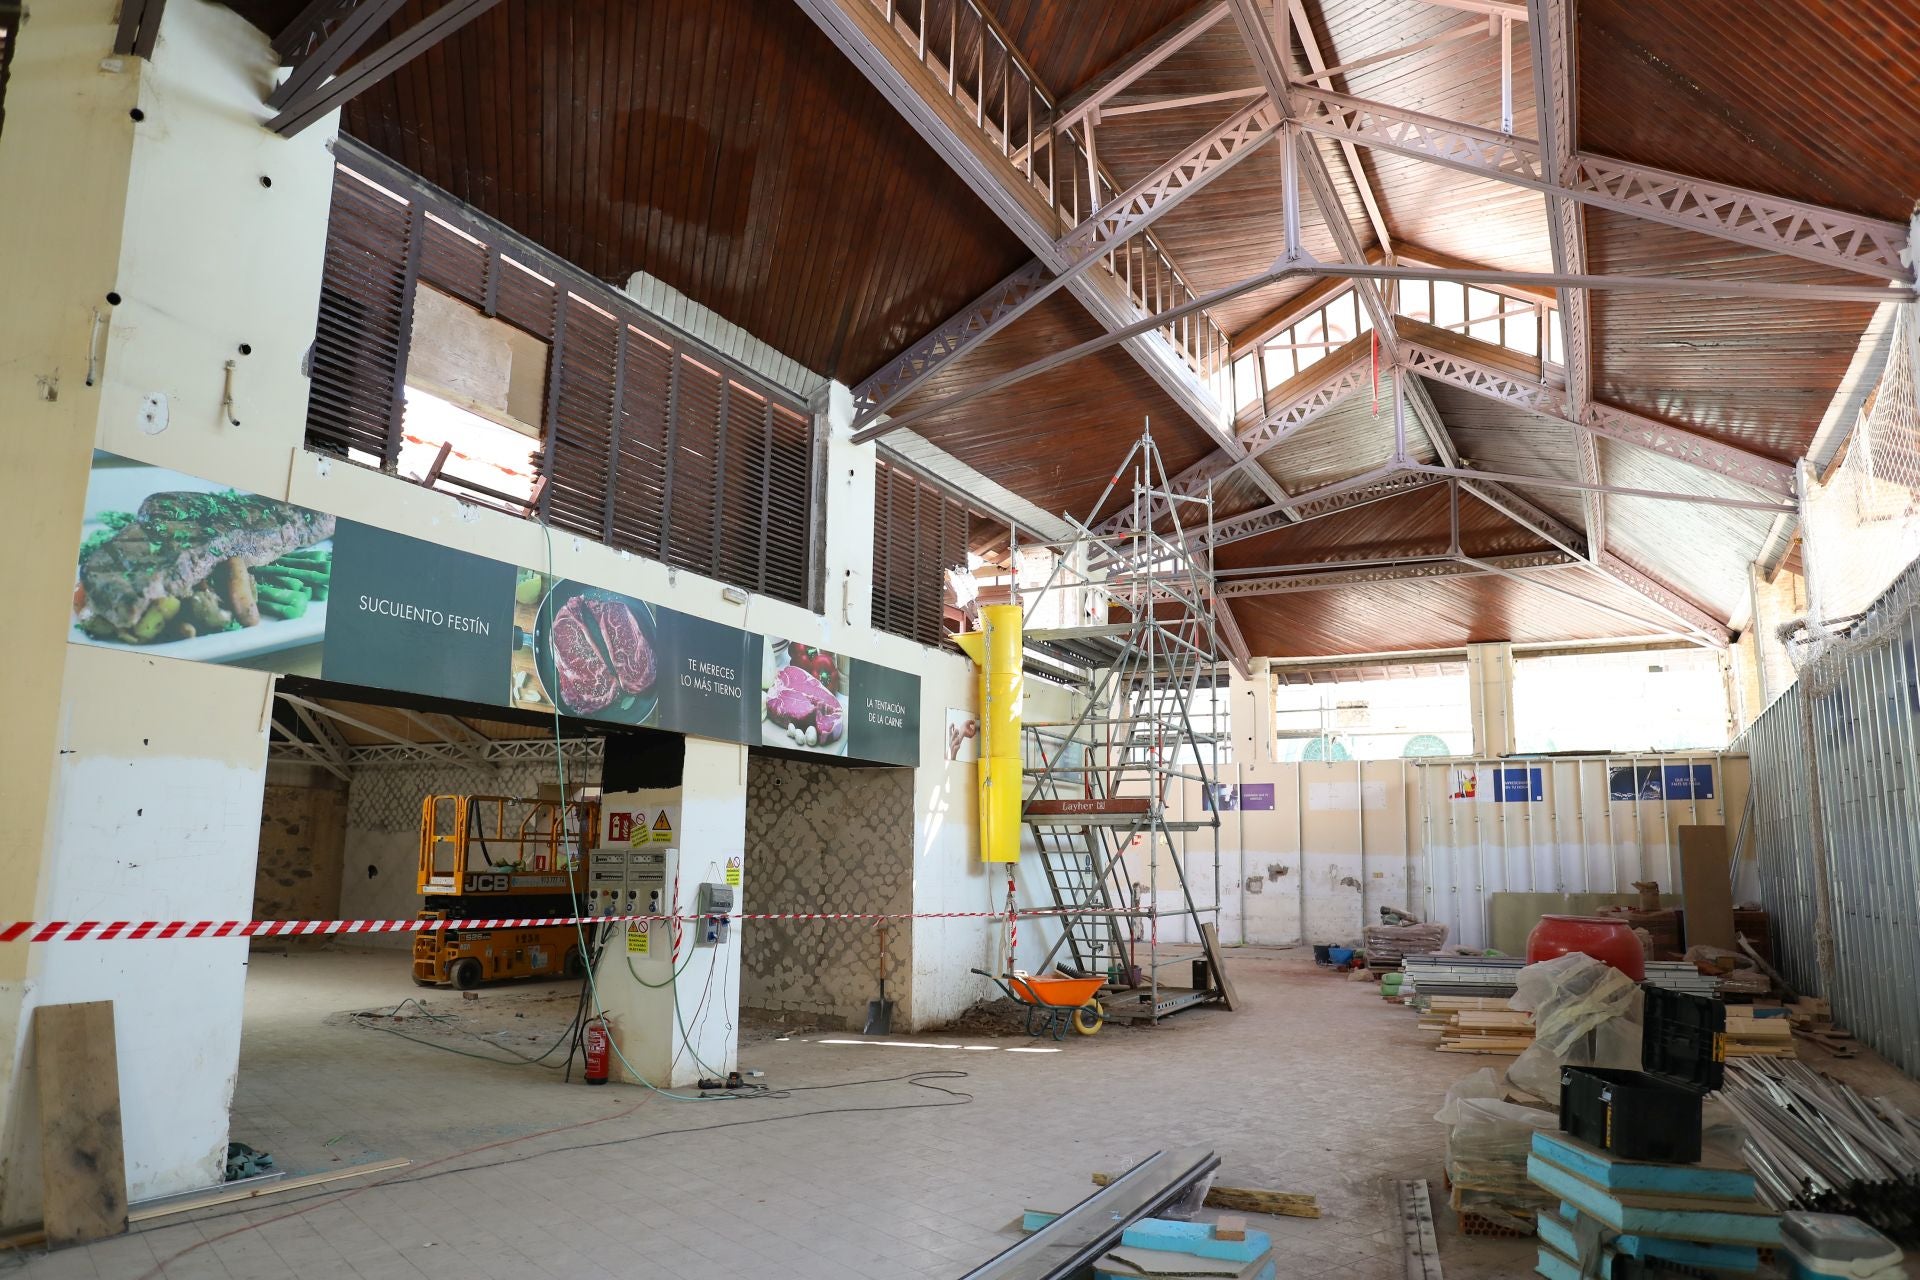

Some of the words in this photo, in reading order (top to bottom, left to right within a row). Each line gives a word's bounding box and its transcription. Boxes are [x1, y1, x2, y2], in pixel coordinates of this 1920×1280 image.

[359, 595, 444, 626] SUCULENTO
[447, 614, 490, 636] FESTÍN
[688, 658, 697, 671] TE
[699, 661, 735, 681] MERECES
[680, 673, 692, 687] LO
[694, 676, 712, 692] MÁS
[713, 681, 742, 698] TIERNO
[866, 697, 873, 708] LA
[874, 699, 906, 715] TENTACIÓN
[868, 712, 876, 723] DE
[877, 714, 883, 724] LA
[884, 716, 903, 729] CARNE
[1062, 801, 1094, 812] Layher
[464, 875, 509, 892] JCB
